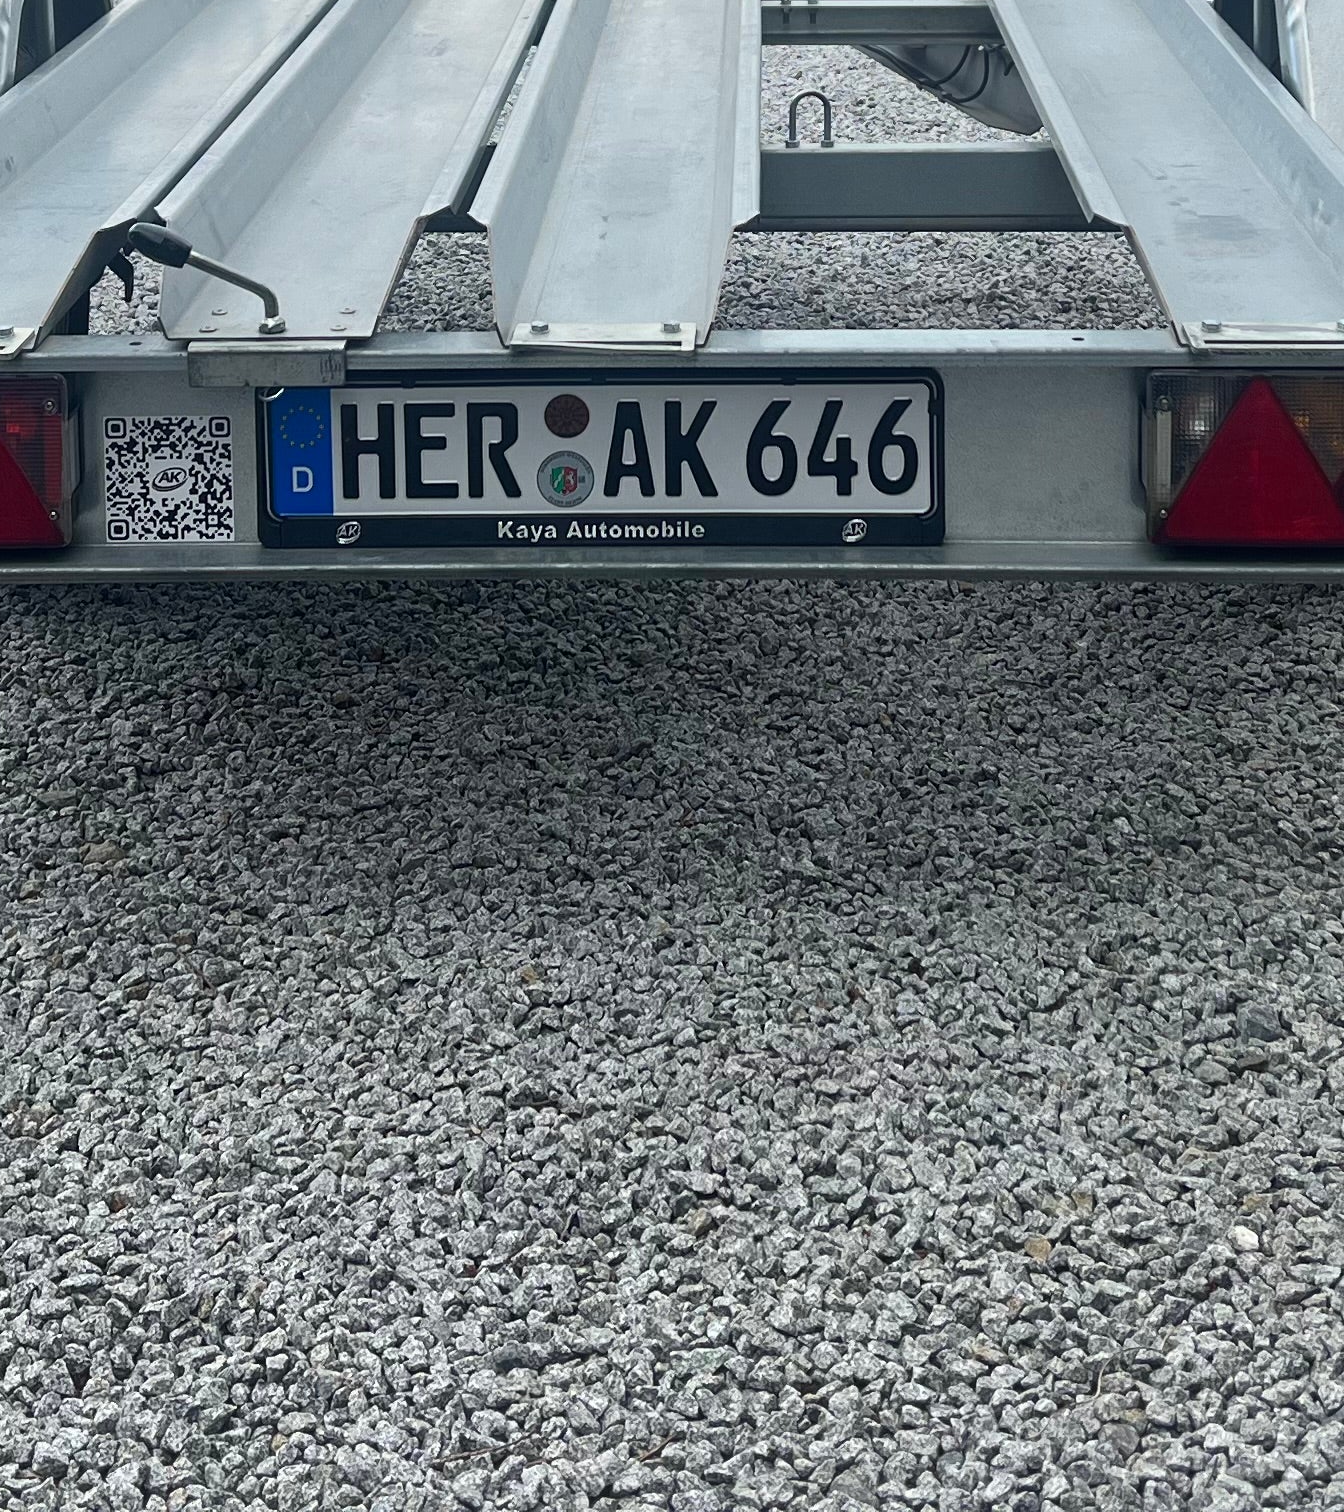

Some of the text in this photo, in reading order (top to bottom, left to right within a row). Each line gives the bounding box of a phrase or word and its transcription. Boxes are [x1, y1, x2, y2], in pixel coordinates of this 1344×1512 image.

[340, 398, 919, 499] HER AK 646
[159, 472, 182, 484] AK
[292, 466, 314, 493] D
[497, 521, 706, 543] Kaya Automobile
